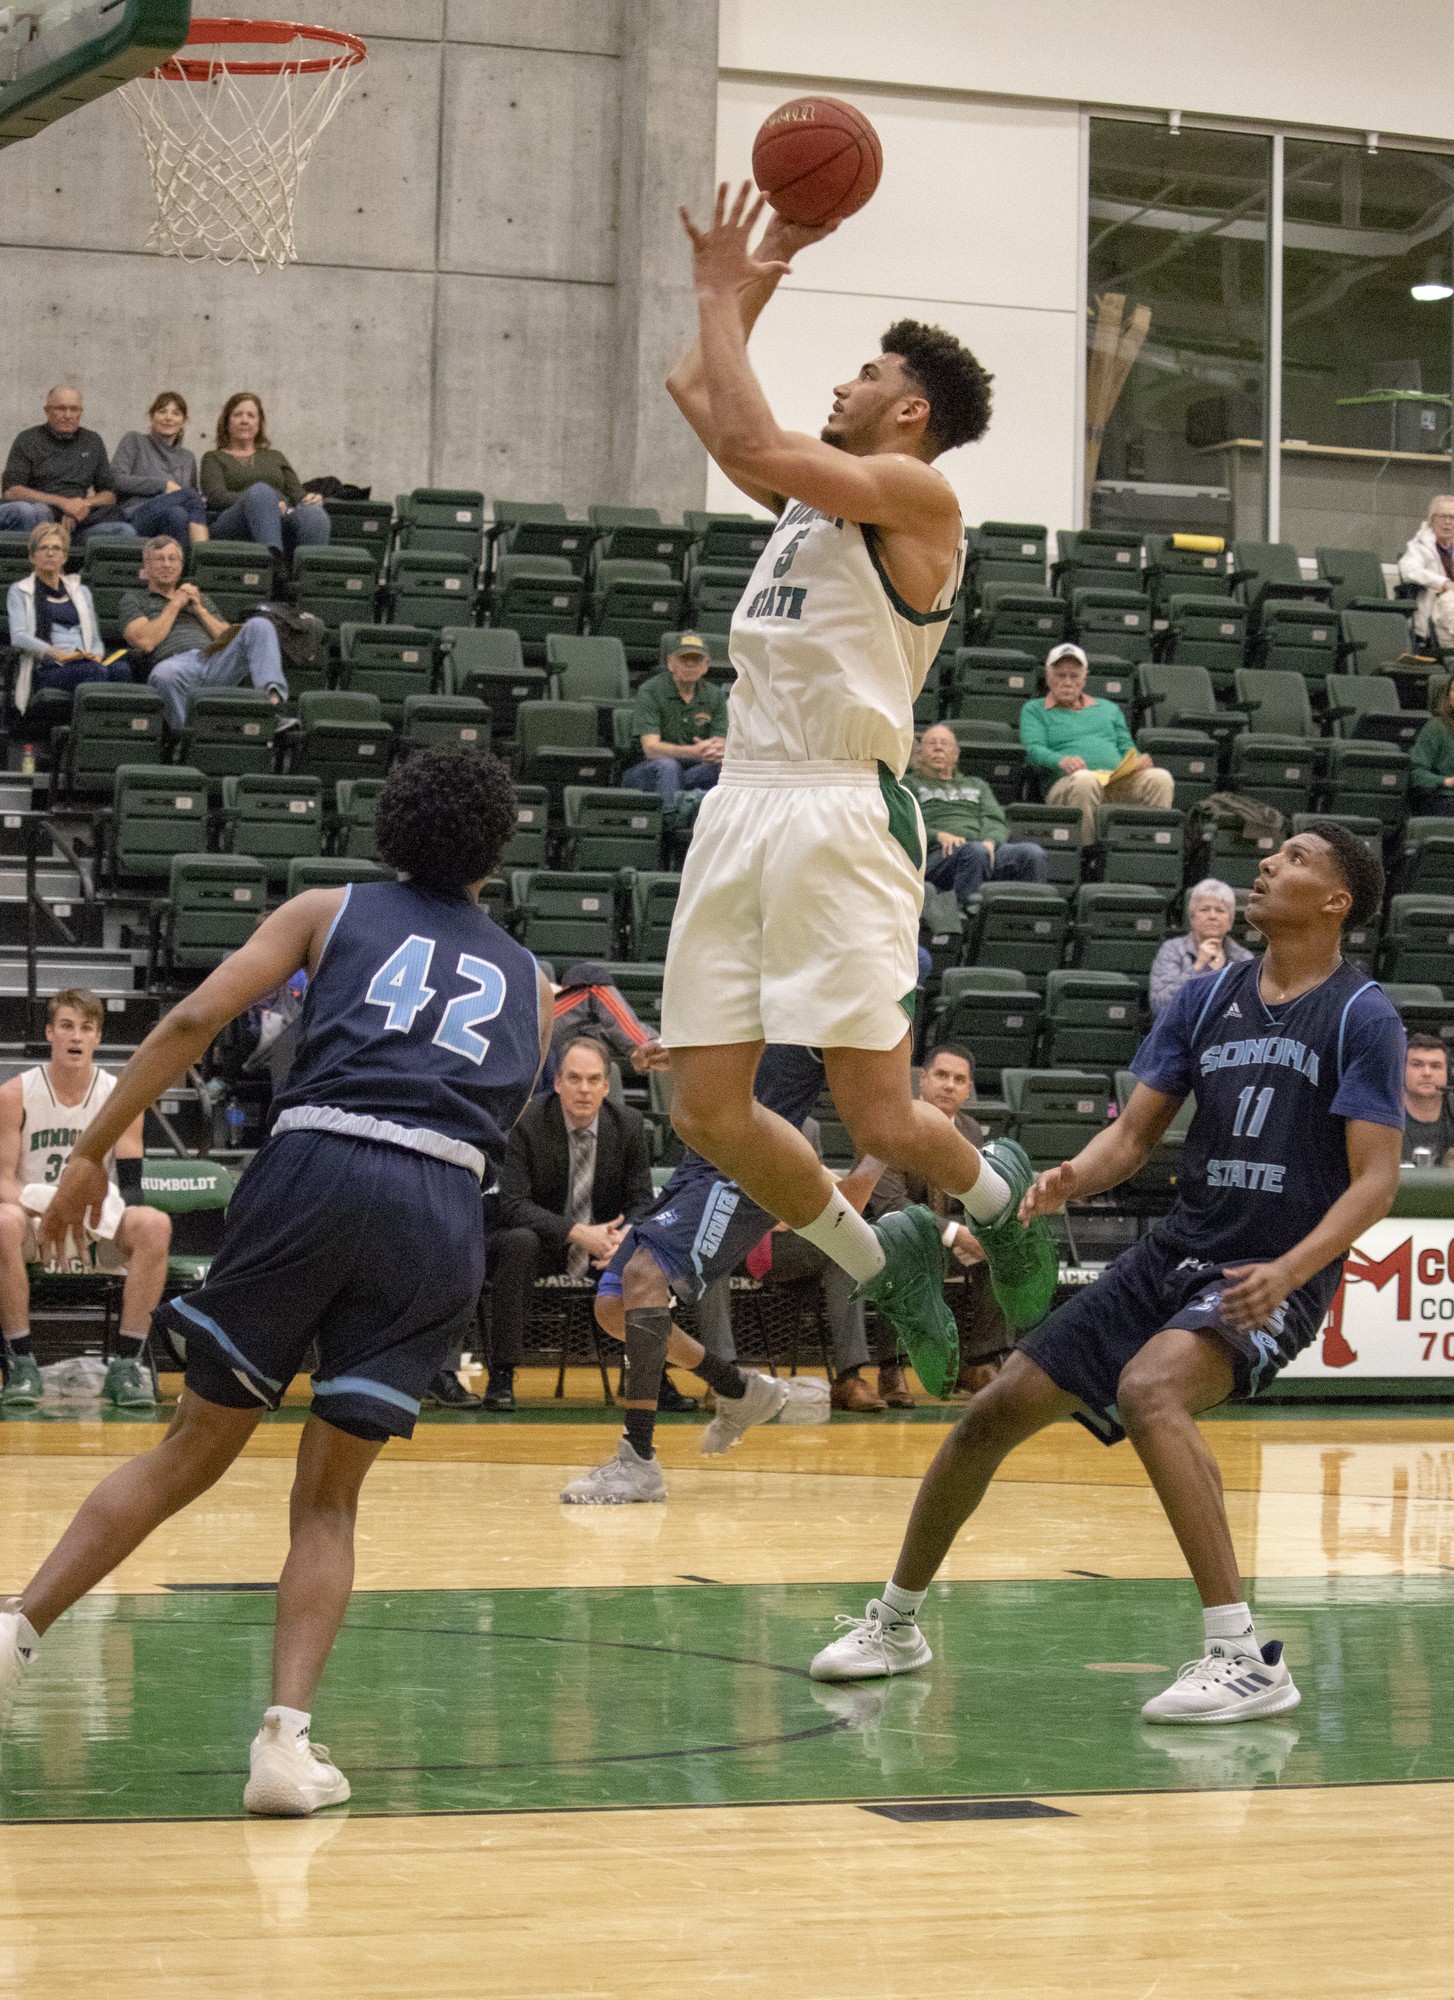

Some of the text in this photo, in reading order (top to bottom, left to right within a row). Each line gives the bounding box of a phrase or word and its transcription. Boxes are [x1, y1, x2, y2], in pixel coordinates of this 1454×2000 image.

[773, 528, 810, 579] 5
[747, 586, 808, 620] STATE
[365, 934, 506, 1066] 42
[1200, 1037, 1320, 1086] SONOMA
[1232, 1086, 1275, 1138] 11
[45, 1154, 70, 1183] 3
[1207, 1159, 1286, 1194] STATE
[141, 1177, 217, 1192] HUMBOLDT
[729, 1277, 764, 1290] CKS
[1058, 1269, 1099, 1285] ACKS
[1421, 1299, 1454, 1320] CO
[1419, 1333, 1454, 1361] 70
